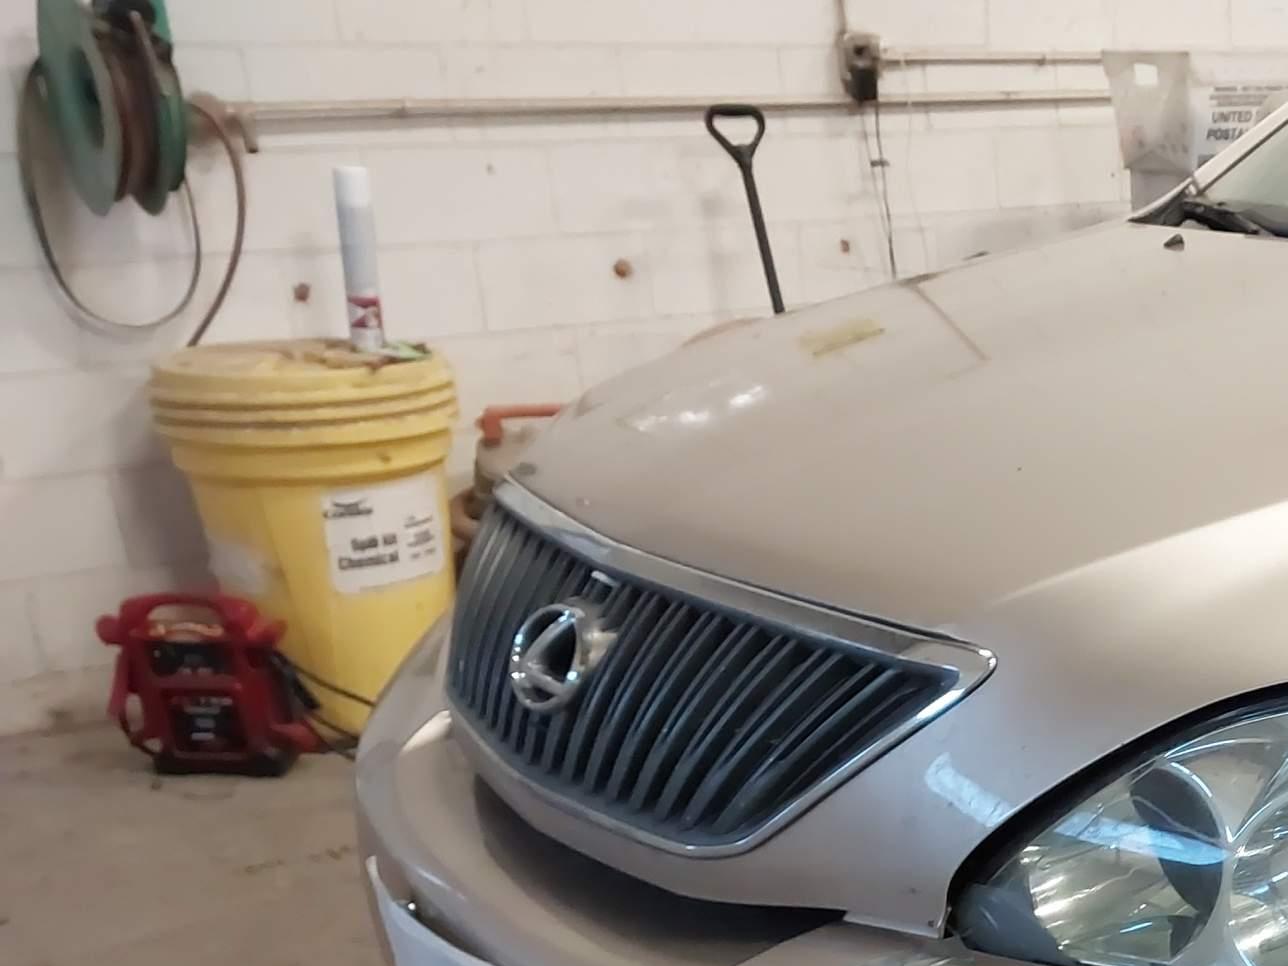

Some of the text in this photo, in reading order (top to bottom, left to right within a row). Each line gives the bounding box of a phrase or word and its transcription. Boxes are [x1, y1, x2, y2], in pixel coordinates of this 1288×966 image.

[1211, 109, 1253, 124] UNITED
[1206, 128, 1249, 141] POSTA
[338, 550, 399, 570] Chemical
